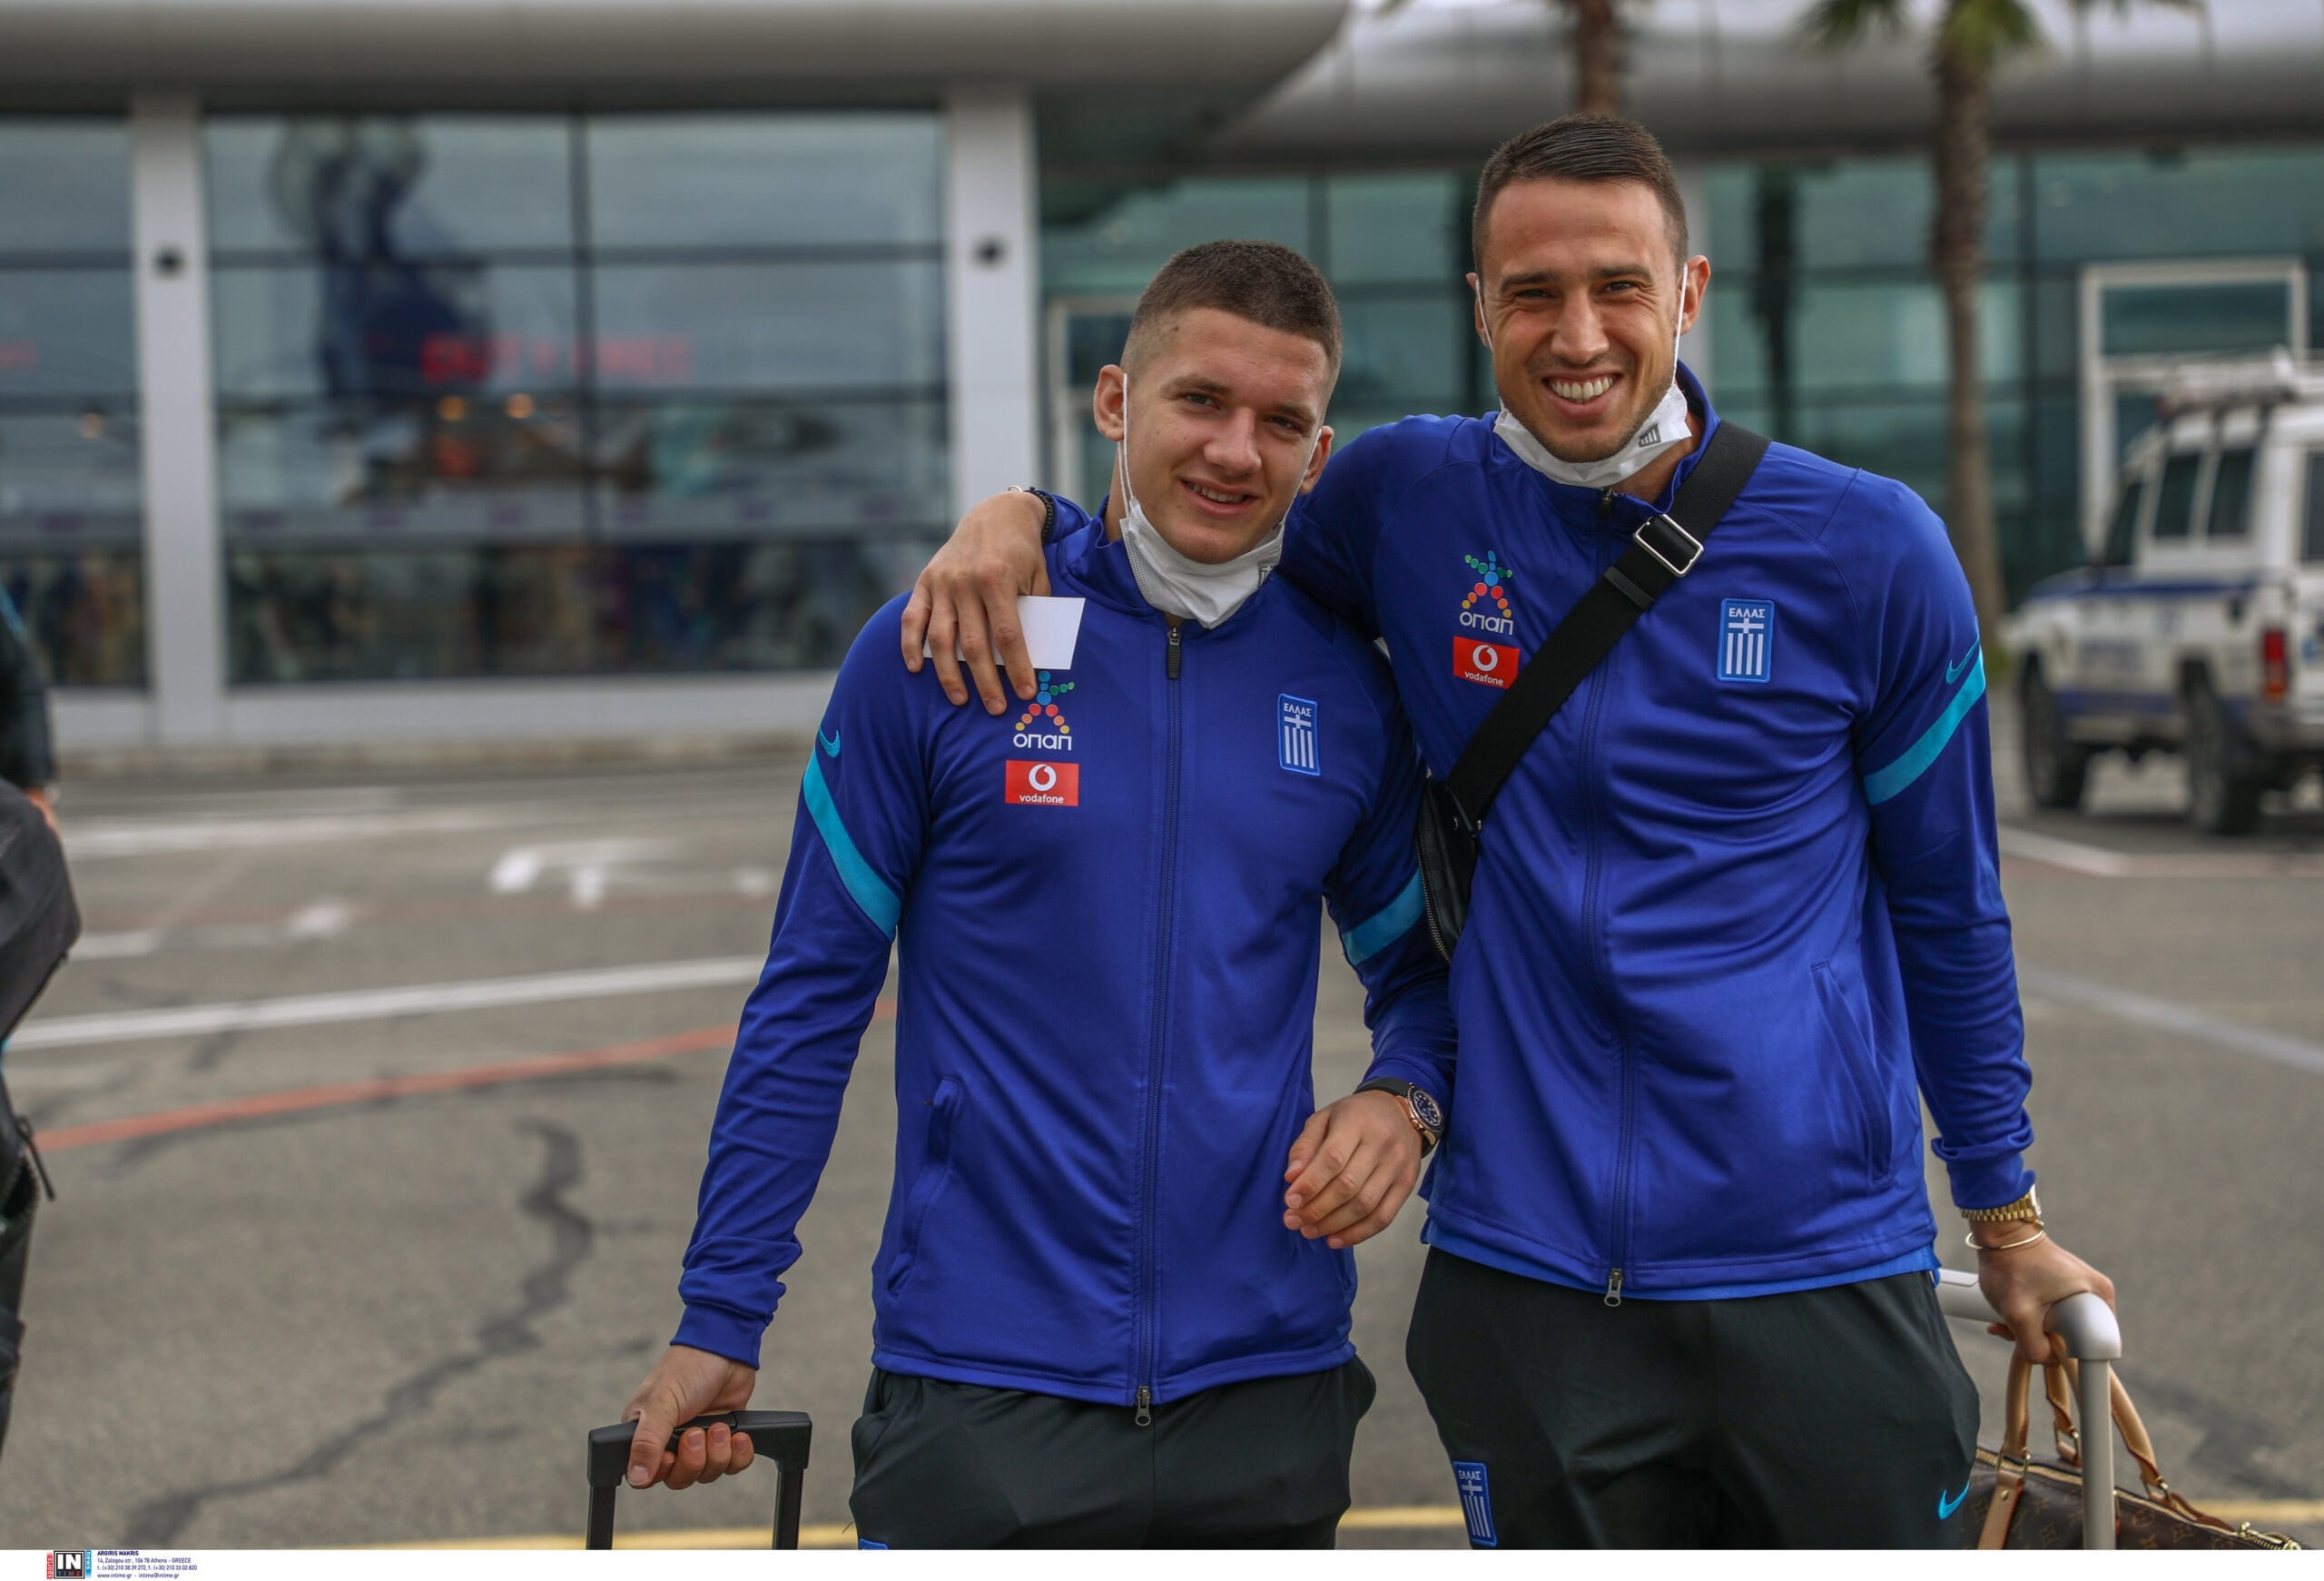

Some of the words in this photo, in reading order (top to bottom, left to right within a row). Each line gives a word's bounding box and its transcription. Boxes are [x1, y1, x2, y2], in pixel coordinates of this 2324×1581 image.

[1728, 608, 1766, 618] ΕΛΛΑΣ
[1464, 671, 1504, 687] vodafone
[1284, 702, 1312, 717] ΕΛΛΑΣ
[1019, 794, 1064, 804] vodafone
